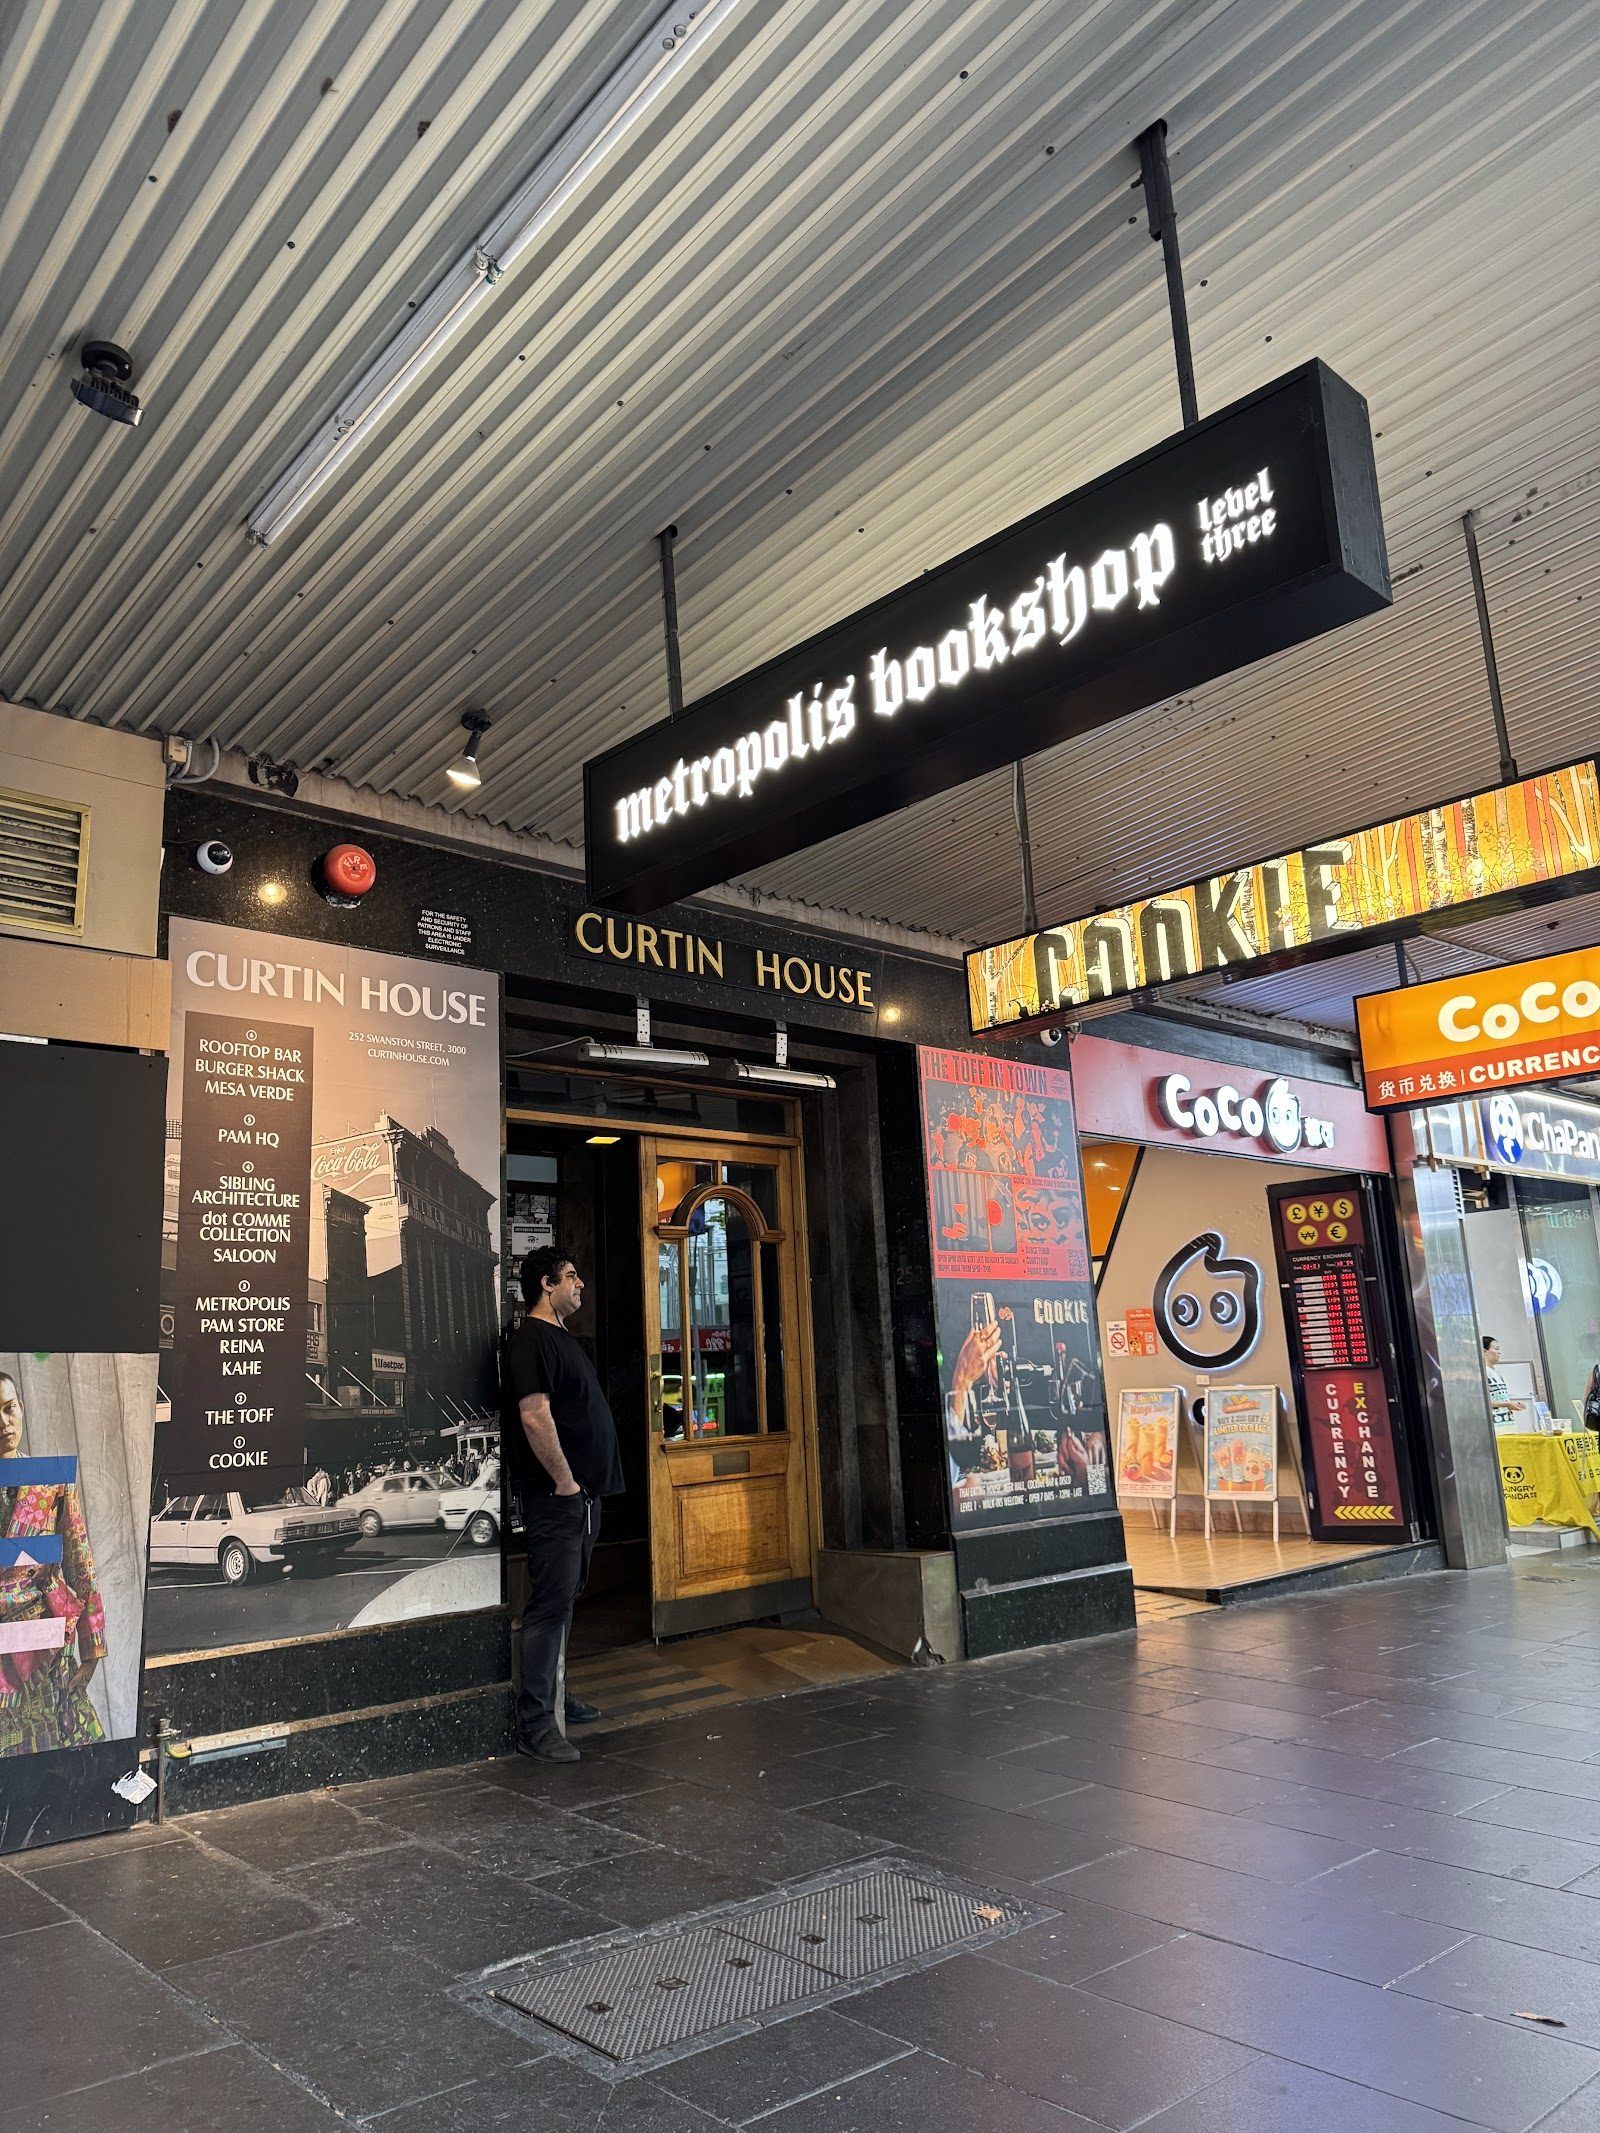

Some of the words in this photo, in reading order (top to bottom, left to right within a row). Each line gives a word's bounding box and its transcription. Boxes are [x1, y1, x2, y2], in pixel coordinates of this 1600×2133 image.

[1198, 466, 1277, 531] level
[1201, 507, 1277, 563] three
[615, 674, 855, 843] metropolis
[870, 522, 1175, 717] bookshop
[343, 855, 368, 871] FIRE
[421, 916, 433, 924] AND
[434, 918, 460, 928] SECURITY
[446, 914, 467, 922] SAFETY
[418, 922, 442, 931] PATRONS
[444, 926, 454, 934] AND
[456, 928, 472, 936] STAFF
[1034, 841, 1363, 1016] COOKIE
[428, 938, 462, 948] ELECTRONIC
[452, 934, 472, 943] UNDER
[425, 943, 465, 955] SURVEILLANCE
[576, 912, 724, 978] CURTIN
[756, 949, 875, 1007] HOUSE
[186, 950, 345, 1007] CURTIN
[361, 976, 486, 1027] HOUSE
[1438, 980, 1600, 1042] CoCo
[199, 1038, 270, 1058] ROOFTOP
[274, 1047, 302, 1063] BAR
[348, 1031, 365, 1042] 252
[366, 1034, 414, 1048] SWANSTON
[416, 1040, 445, 1053] STREET,
[447, 1044, 466, 1054] 3000
[367, 1048, 450, 1066] CURTINHOUSE.COM
[195, 1058, 254, 1078] BURGER
[257, 1064, 304, 1084] SHACK
[922, 1050, 949, 1080] THE
[952, 1055, 984, 1085] TOFF
[988, 1062, 1004, 1088] IN
[1007, 1065, 1048, 1095] TOWN
[205, 1080, 246, 1097] MESA
[250, 1084, 294, 1101] VERDE
[1378, 1070, 1457, 1100] 货币兑换
[1160, 1073, 1264, 1137] CoCo
[218, 1129, 251, 1144] PAM
[256, 1132, 280, 1148] HQ
[220, 1176, 275, 1192] SIBLING
[192, 1190, 300, 1208] ARCHITECTURE
[1340, 1201, 1348, 1216] $
[202, 1210, 227, 1226] dot
[232, 1212, 290, 1228] COMME
[200, 1227, 290, 1242] COLLECTION
[214, 1248, 276, 1263] SALOON
[1322, 1252, 1352, 1260] EXCHANGE
[196, 1297, 290, 1312] METROPOLIS
[1034, 1298, 1089, 1324] COOKIE
[200, 1318, 234, 1332] PAM
[238, 1318, 284, 1332] STORE
[220, 1339, 264, 1354] REINA
[222, 1360, 262, 1376] KAHE
[374, 1358, 404, 1370] Westpac
[205, 1410, 234, 1426] THE
[238, 1408, 274, 1424] TOFF
[1218, 1415, 1230, 1425] BUY
[1214, 1425, 1239, 1436] LIMITED
[1325, 1383, 1350, 1498] CURRENCY
[1353, 1382, 1378, 1498] EXCHANGE
[209, 1451, 268, 1469] COOKIE
